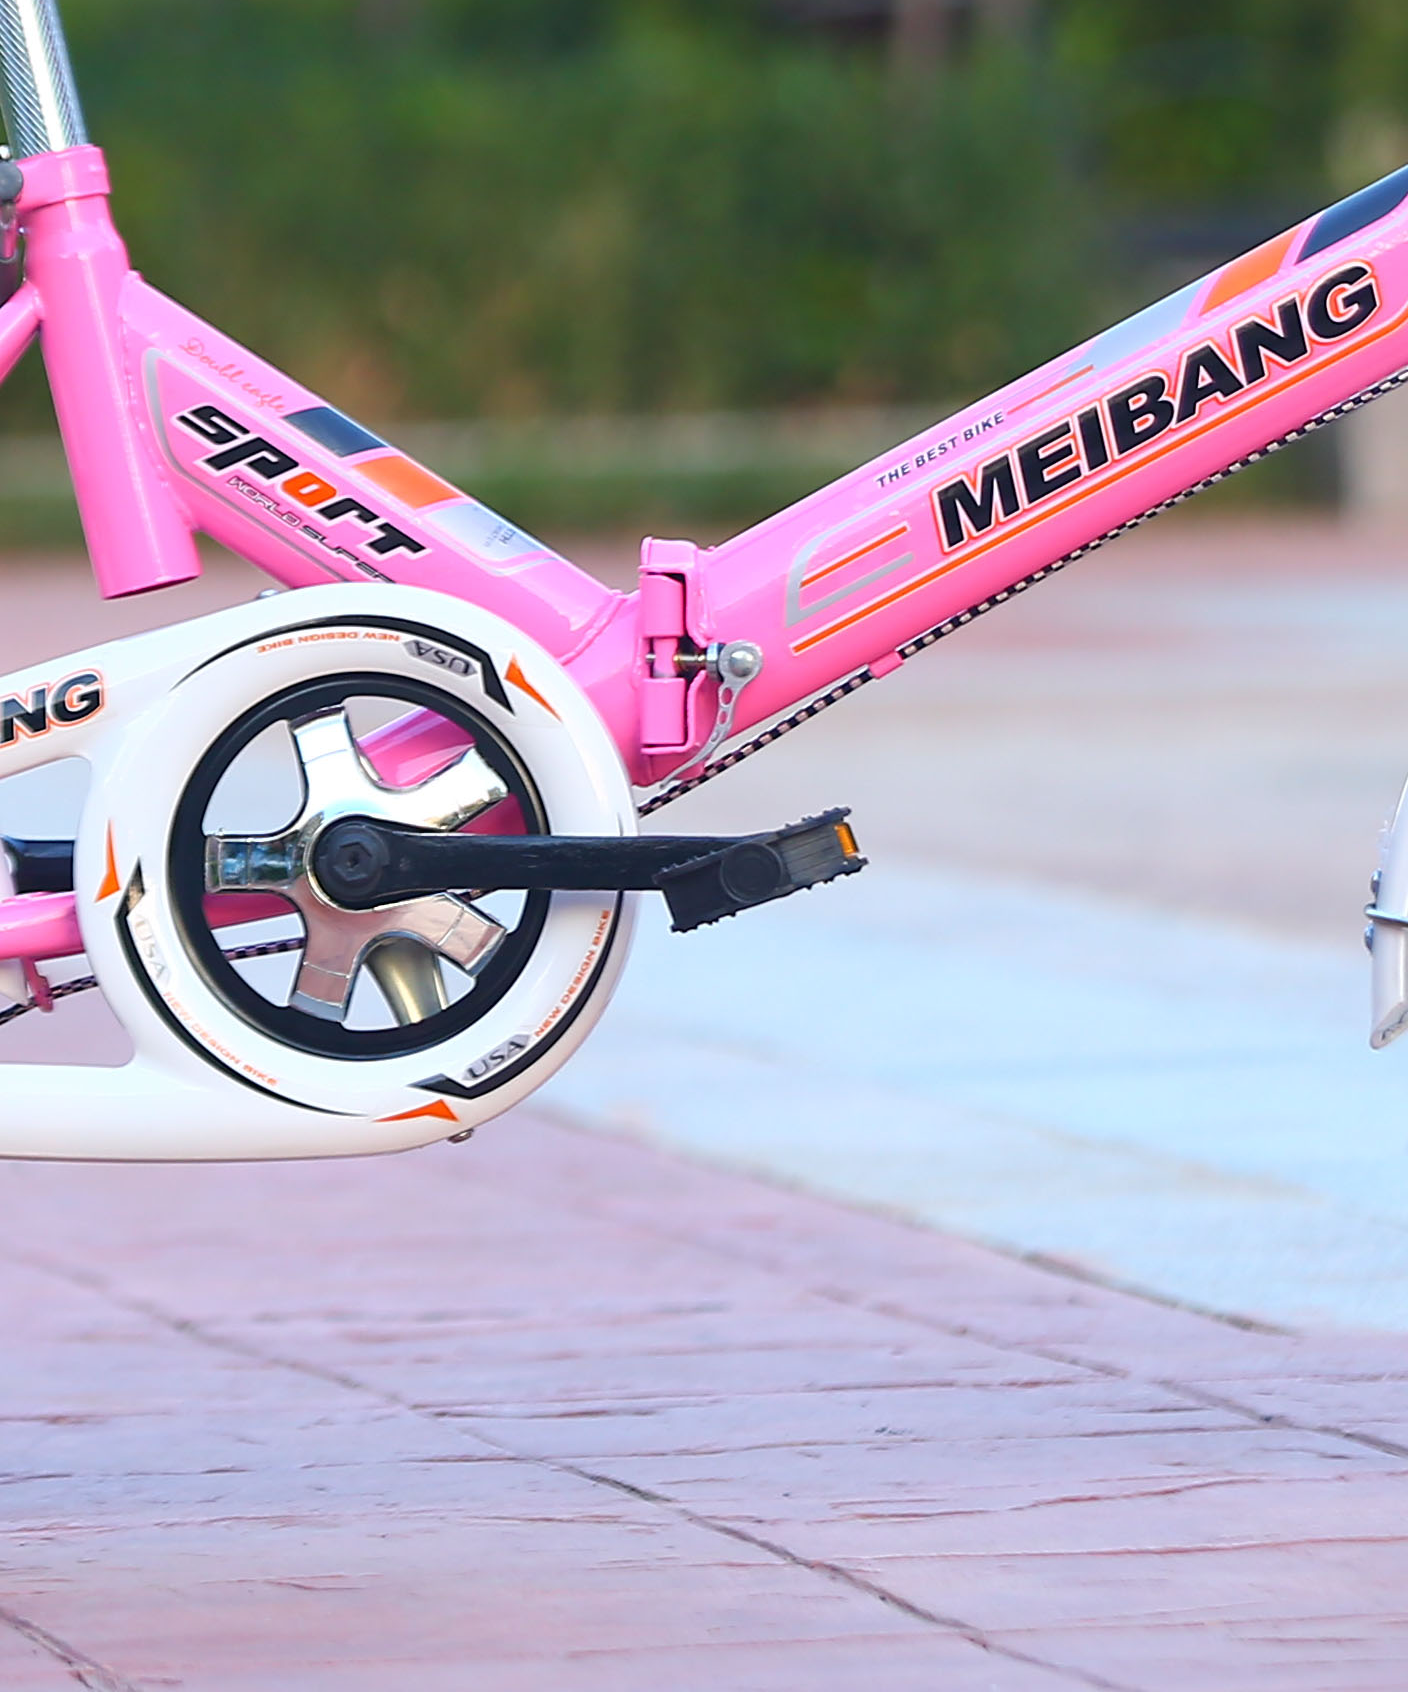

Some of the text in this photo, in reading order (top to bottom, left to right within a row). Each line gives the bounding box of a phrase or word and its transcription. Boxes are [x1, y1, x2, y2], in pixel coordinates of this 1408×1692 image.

[932, 263, 1380, 551] MEIBANG
[876, 411, 1005, 488] THE BEST BIKE
[226, 475, 303, 528] WORLD
[257, 631, 472, 676] USA NEW DESIGN BIKE
[467, 910, 612, 1079] USA NEW DESIGN BIKE
[190, 1022, 241, 1065] DESIGN
[242, 1063, 278, 1087] BIKE
